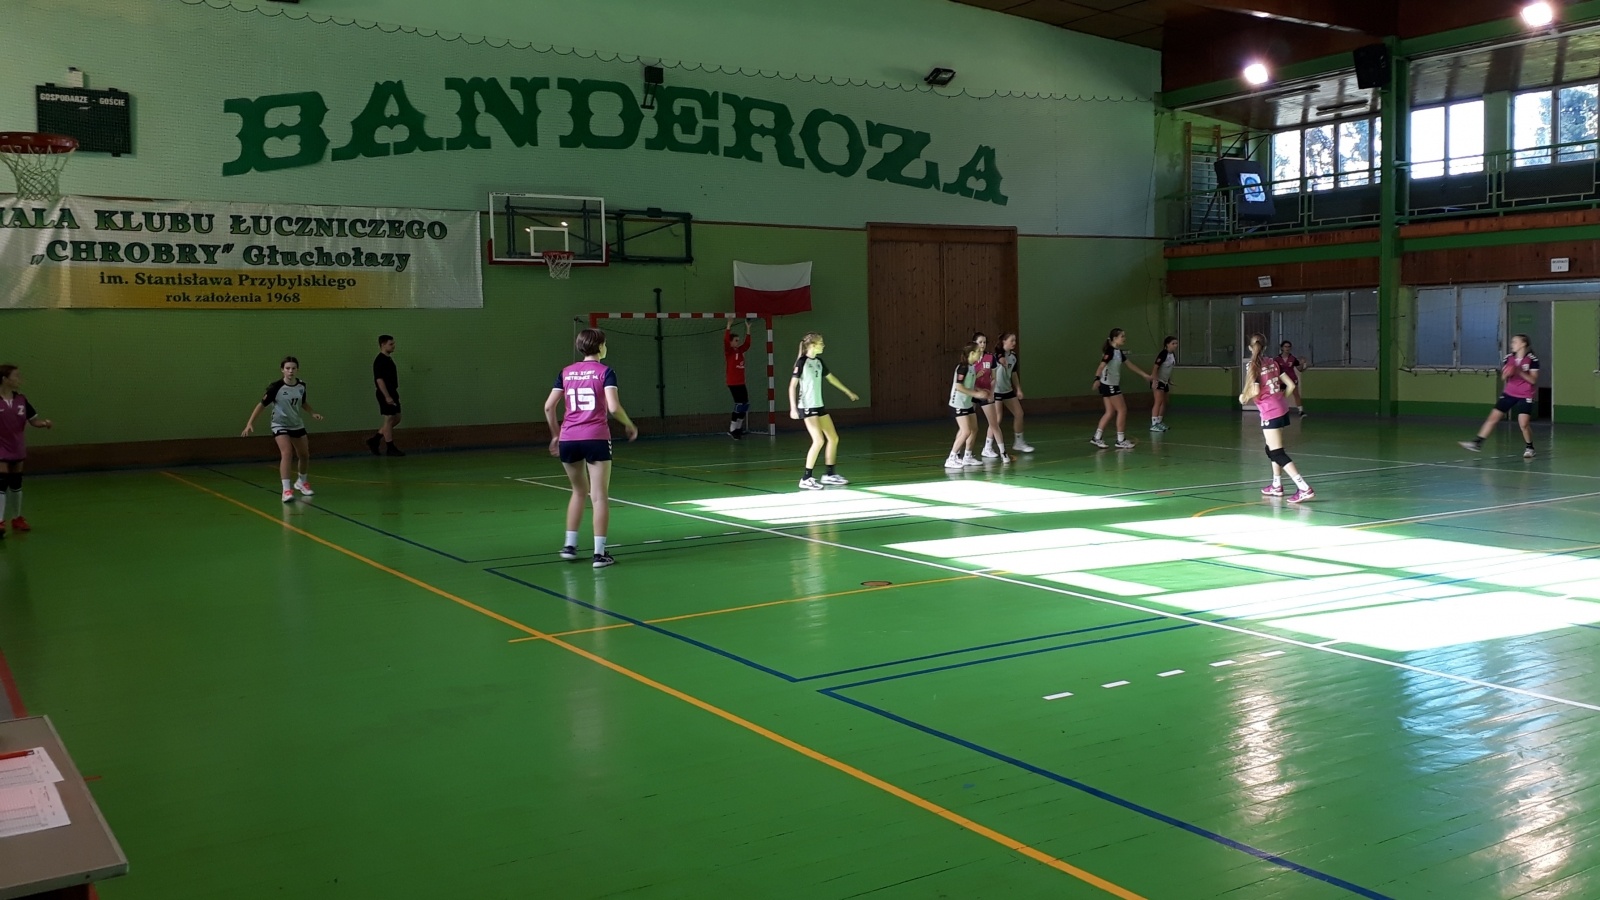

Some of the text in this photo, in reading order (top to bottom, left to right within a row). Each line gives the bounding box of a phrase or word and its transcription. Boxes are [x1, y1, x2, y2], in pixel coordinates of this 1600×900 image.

[40, 93, 88, 104] GOSPODARZE
[99, 96, 125, 106] GOŚCIE
[222, 76, 1009, 205] BANDEROZA
[94, 209, 215, 233] KLUBU
[229, 214, 448, 240] ŁUCZNICZEGO
[242, 245, 411, 272] Głuchołazy
[99, 272, 357, 290] im. Stanisława Przybylskiego
[165, 293, 301, 303] rok założenia 1968
[566, 387, 596, 412] 15
